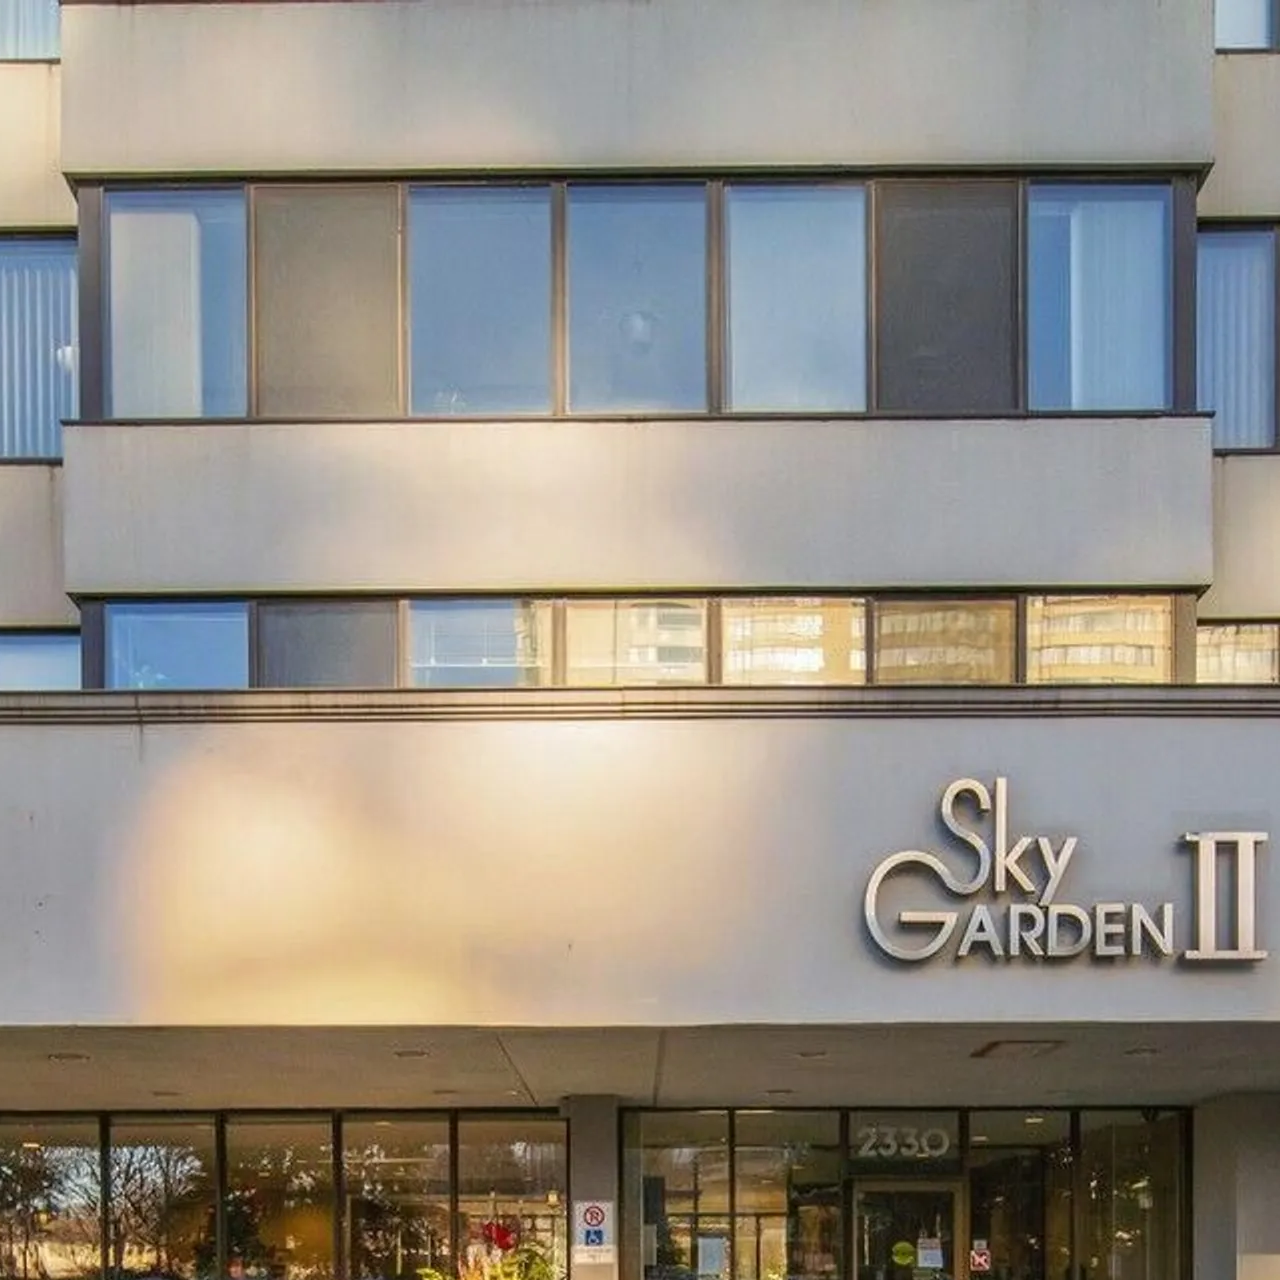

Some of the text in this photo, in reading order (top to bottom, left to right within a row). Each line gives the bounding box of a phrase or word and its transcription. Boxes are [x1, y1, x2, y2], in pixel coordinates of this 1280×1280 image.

[863, 831, 1269, 962] GARDEN II
[940, 776, 1078, 907] Sky
[858, 1127, 950, 1158] 2330
